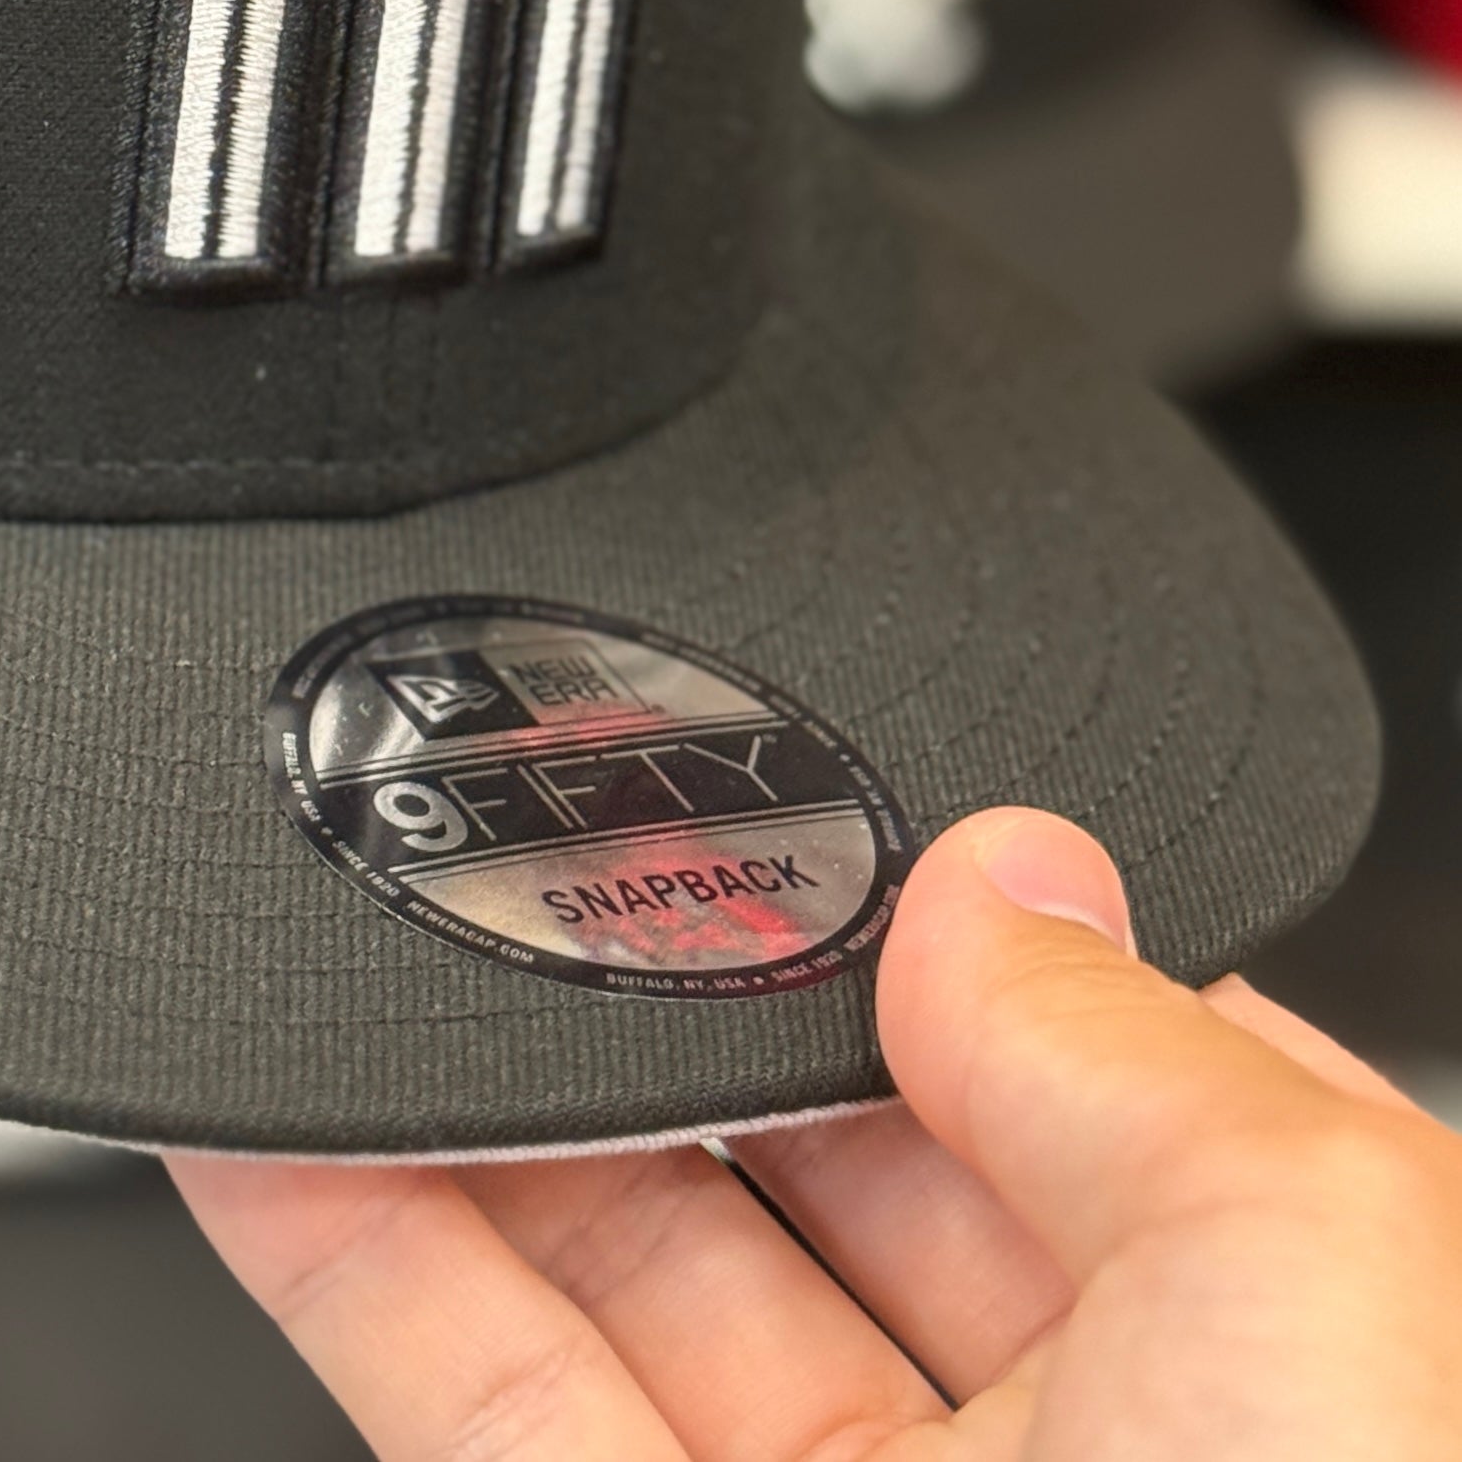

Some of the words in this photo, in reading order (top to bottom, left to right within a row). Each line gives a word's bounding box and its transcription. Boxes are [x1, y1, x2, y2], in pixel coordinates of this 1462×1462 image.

[508, 655, 596, 685] NEW
[531, 679, 619, 707] ERA
[372, 735, 779, 853] 9FIFTY
[331, 839, 370, 872] SINCE
[365, 870, 402, 898] 1920
[405, 899, 536, 964] NEWERACAP.COM
[541, 854, 820, 925] SNAPBACK
[713, 976, 746, 989] USA
[770, 963, 814, 982] SINCE
